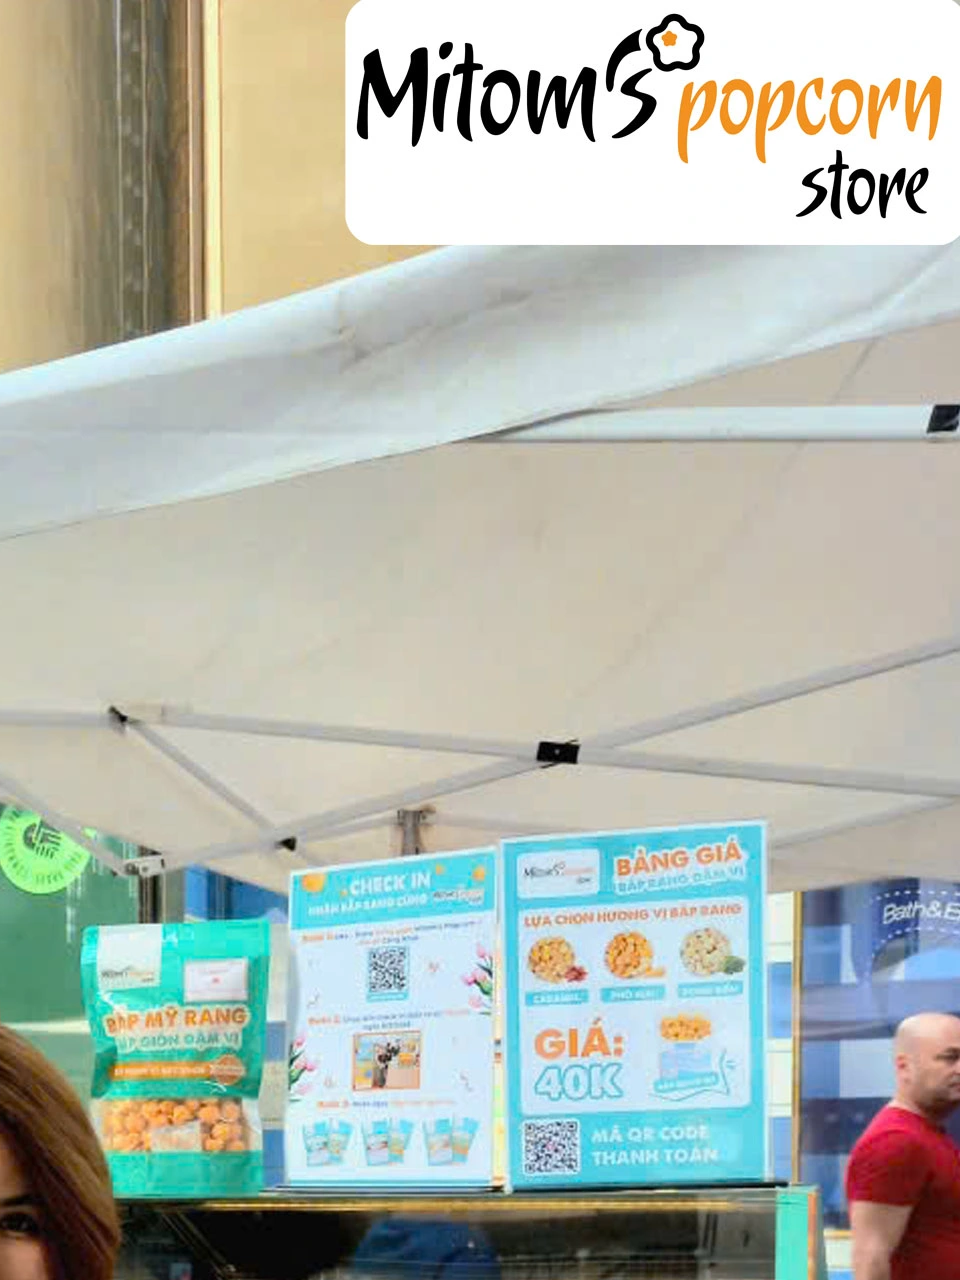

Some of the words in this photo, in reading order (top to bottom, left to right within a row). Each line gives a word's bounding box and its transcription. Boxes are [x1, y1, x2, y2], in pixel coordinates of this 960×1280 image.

[616, 847, 689, 877] BẢNG
[695, 838, 743, 864] GIÁ
[350, 873, 407, 895] CHECK
[411, 871, 432, 891] IN
[184, 1007, 247, 1026] RANG
[534, 1016, 624, 1060] GIÁ:
[534, 1062, 624, 1102] 40K
[628, 1126, 655, 1142] QR
[660, 1123, 710, 1141] CODE
[591, 1149, 660, 1166] THANH
